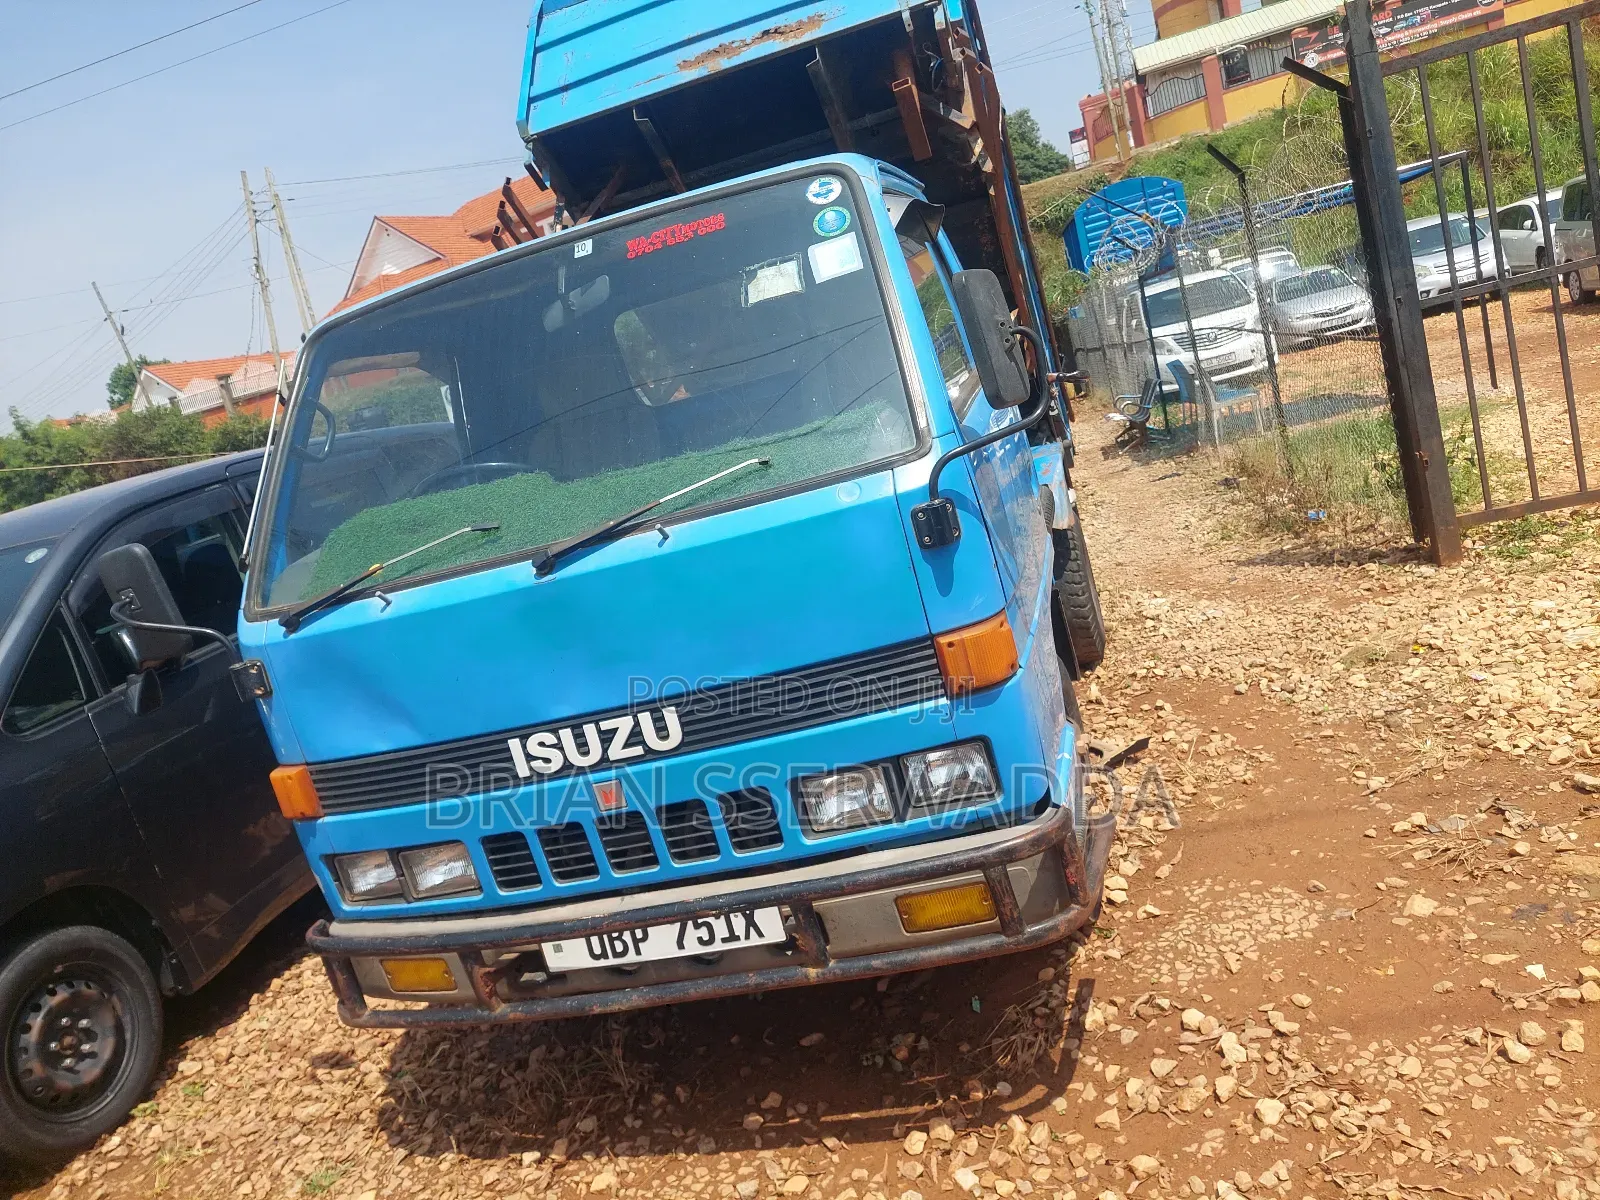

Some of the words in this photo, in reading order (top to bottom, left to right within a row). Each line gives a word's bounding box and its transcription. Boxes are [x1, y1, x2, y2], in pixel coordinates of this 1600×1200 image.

[1440, 16, 1457, 26] Supply
[1458, 12, 1473, 20] Chain
[507, 707, 685, 779] ISUZU
[674, 909, 766, 951] 751X
